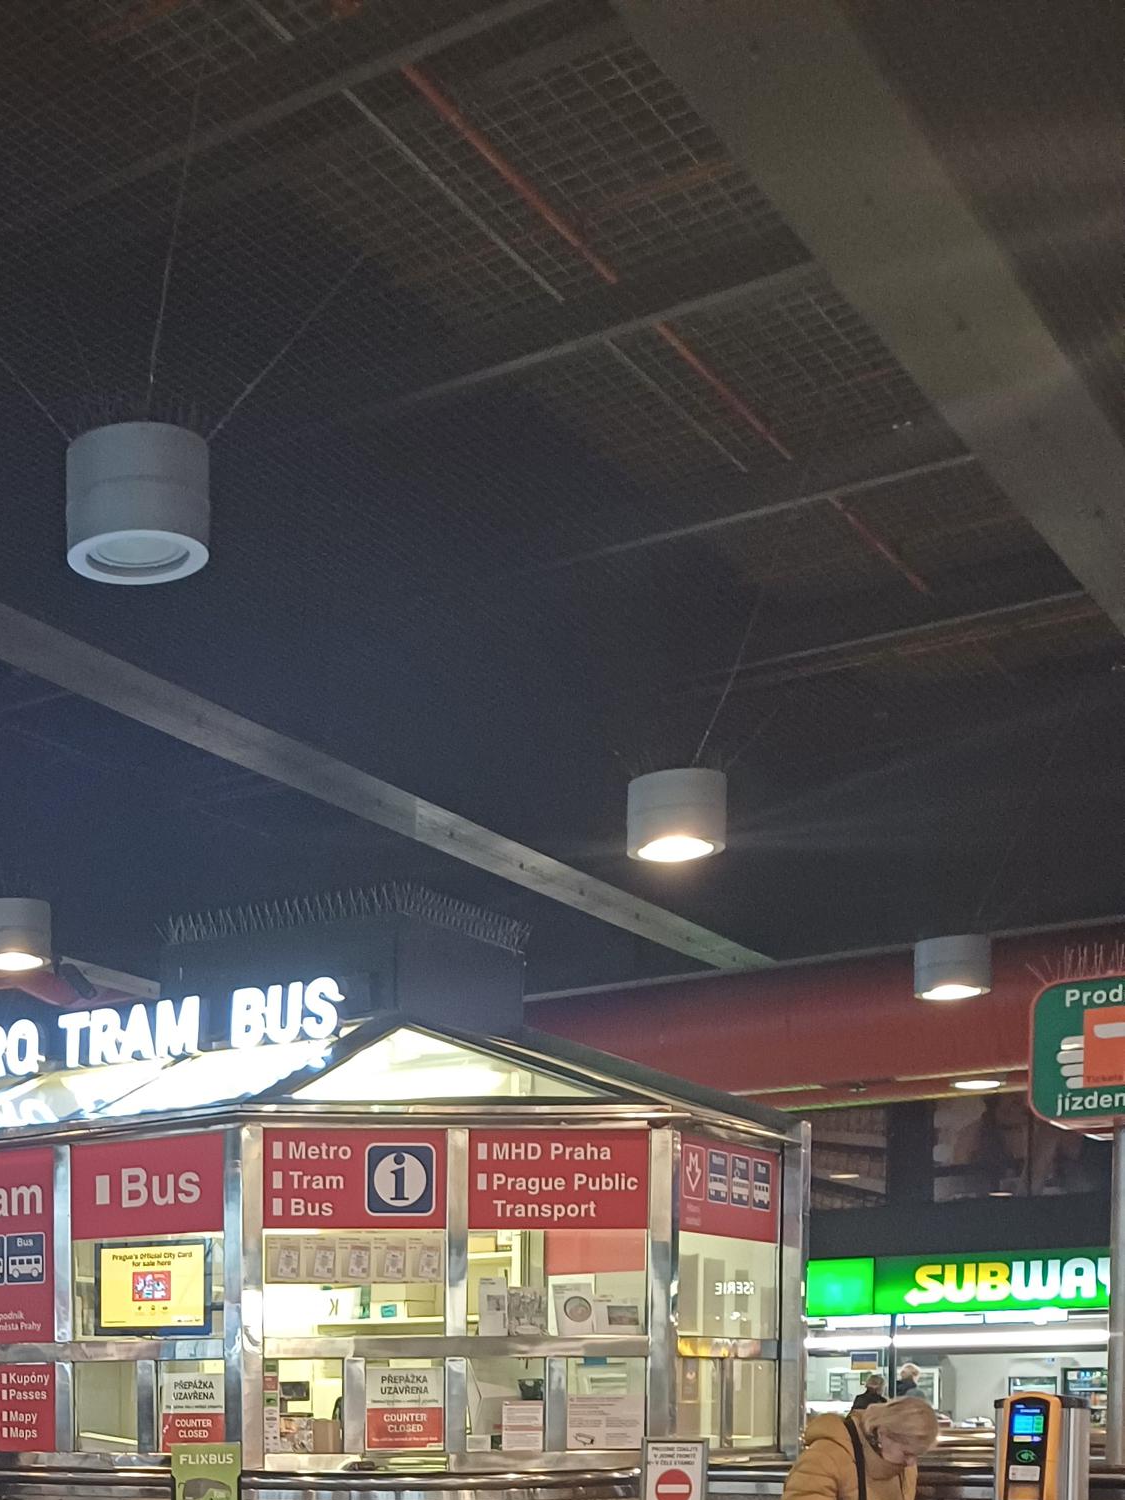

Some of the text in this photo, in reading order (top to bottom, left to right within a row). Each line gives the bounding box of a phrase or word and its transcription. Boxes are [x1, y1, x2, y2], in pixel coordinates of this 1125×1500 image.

[58, 995, 200, 1069] TRAM
[229, 976, 345, 1048] BUS
[289, 1141, 352, 1159] Metro
[493, 1142, 611, 1160] MHD Praha
[289, 1171, 344, 1189] Tram
[493, 1172, 639, 1195] Prague Public
[121, 1167, 201, 1208] Bus
[291, 1198, 333, 1216] Bus
[493, 1200, 597, 1221] Transport
[17, 1237, 33, 1247] Bus
[163, 1252, 176, 1260] City
[20, 1321, 41, 1331] Prahy
[9, 1371, 50, 1386] Kupóny
[9, 1389, 47, 1400] Passes
[9, 1410, 38, 1424] Mapy
[175, 1419, 212, 1428] COUNTER
[383, 1413, 427, 1422] COUNTER
[9, 1427, 38, 1440] Maps
[178, 1429, 209, 1438] CLOSED
[387, 1424, 424, 1433] CLOSED
[179, 1453, 234, 1465] FLIXBUS
